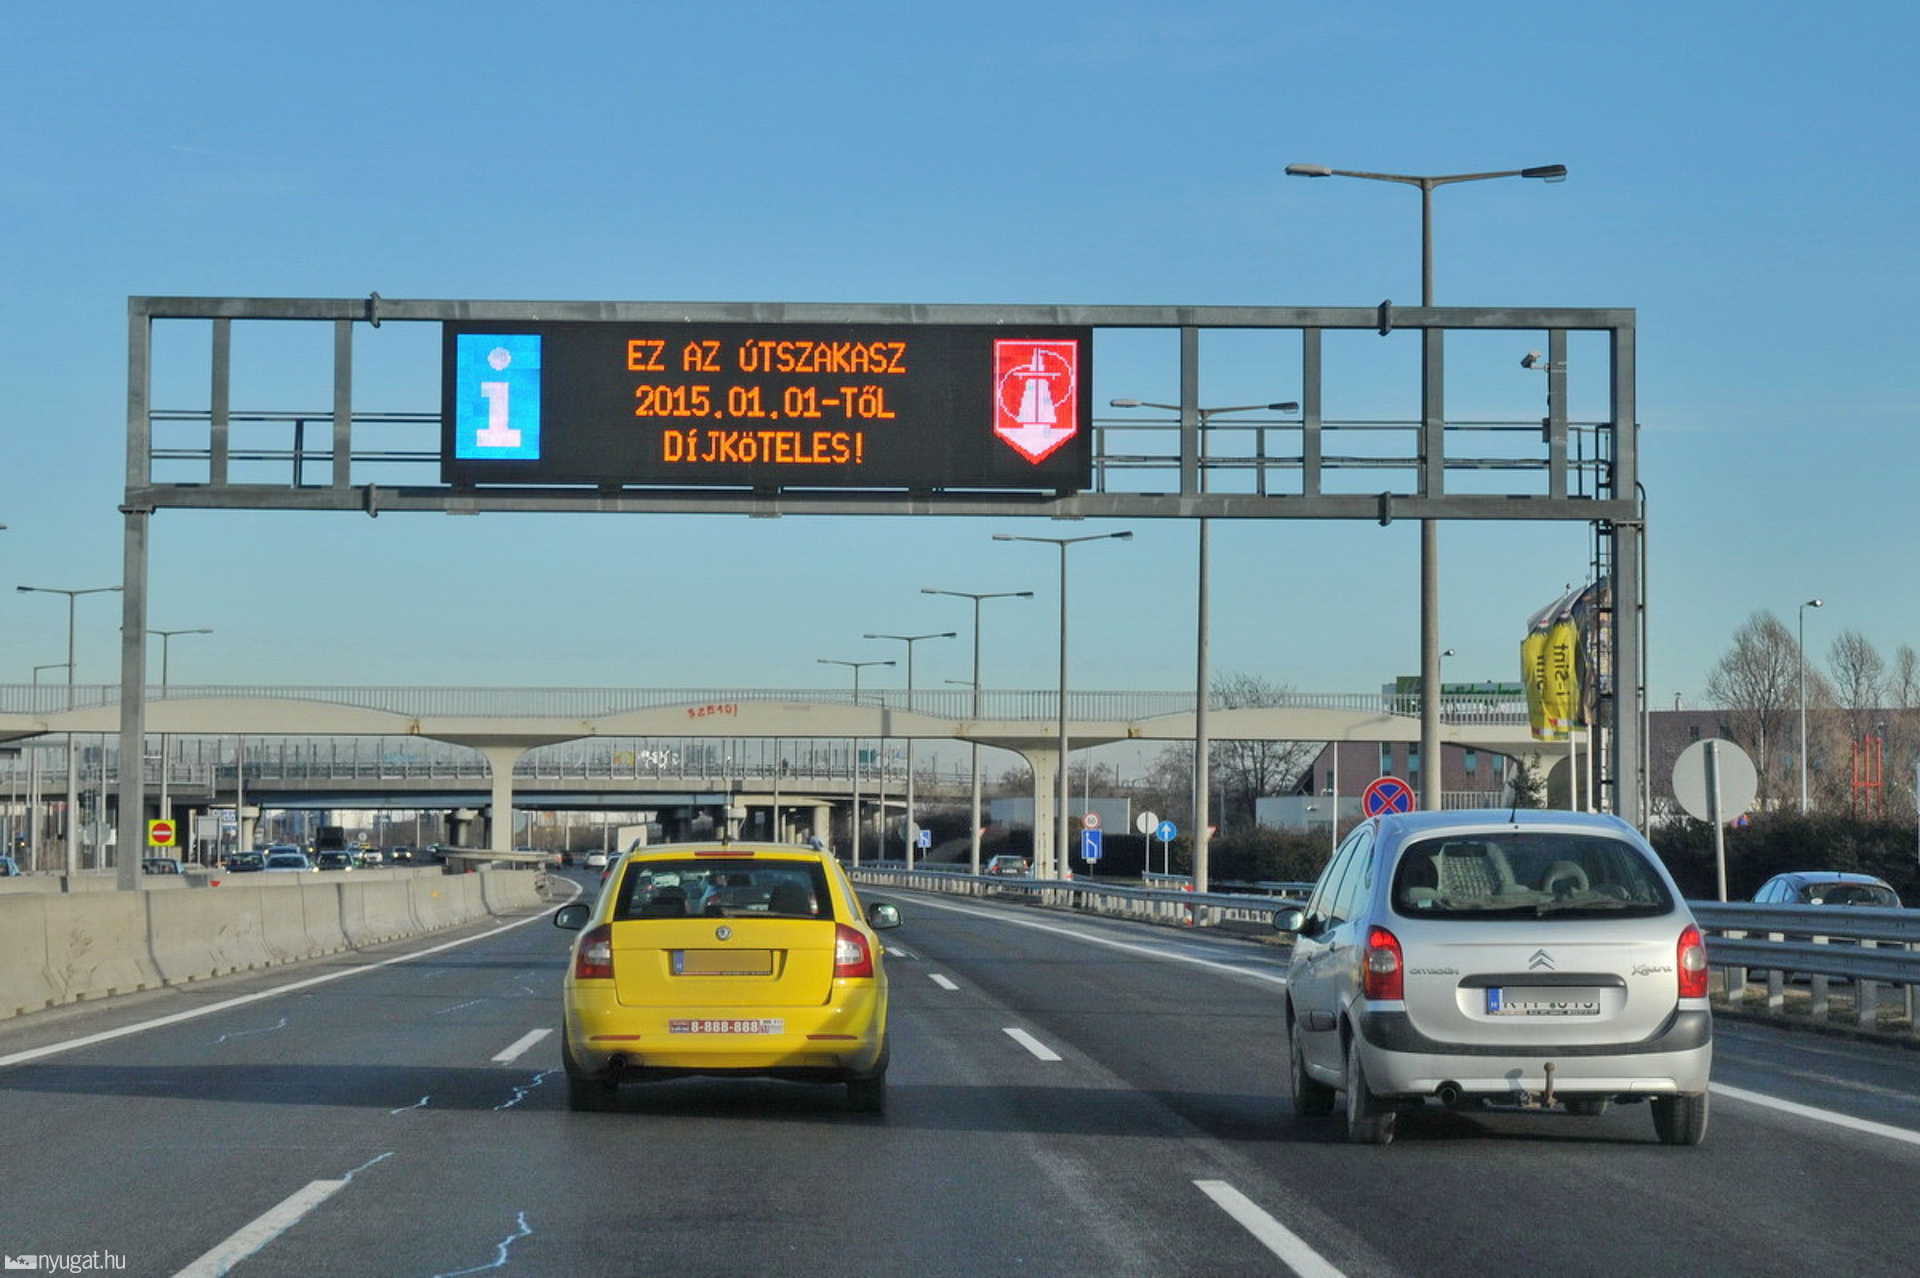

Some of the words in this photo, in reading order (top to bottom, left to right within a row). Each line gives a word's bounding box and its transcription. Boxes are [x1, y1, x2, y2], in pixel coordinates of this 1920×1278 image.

[627, 339, 665, 371] EZ
[683, 341, 721, 371] AZ
[738, 339, 906, 373] ÚTSZAKASZ
